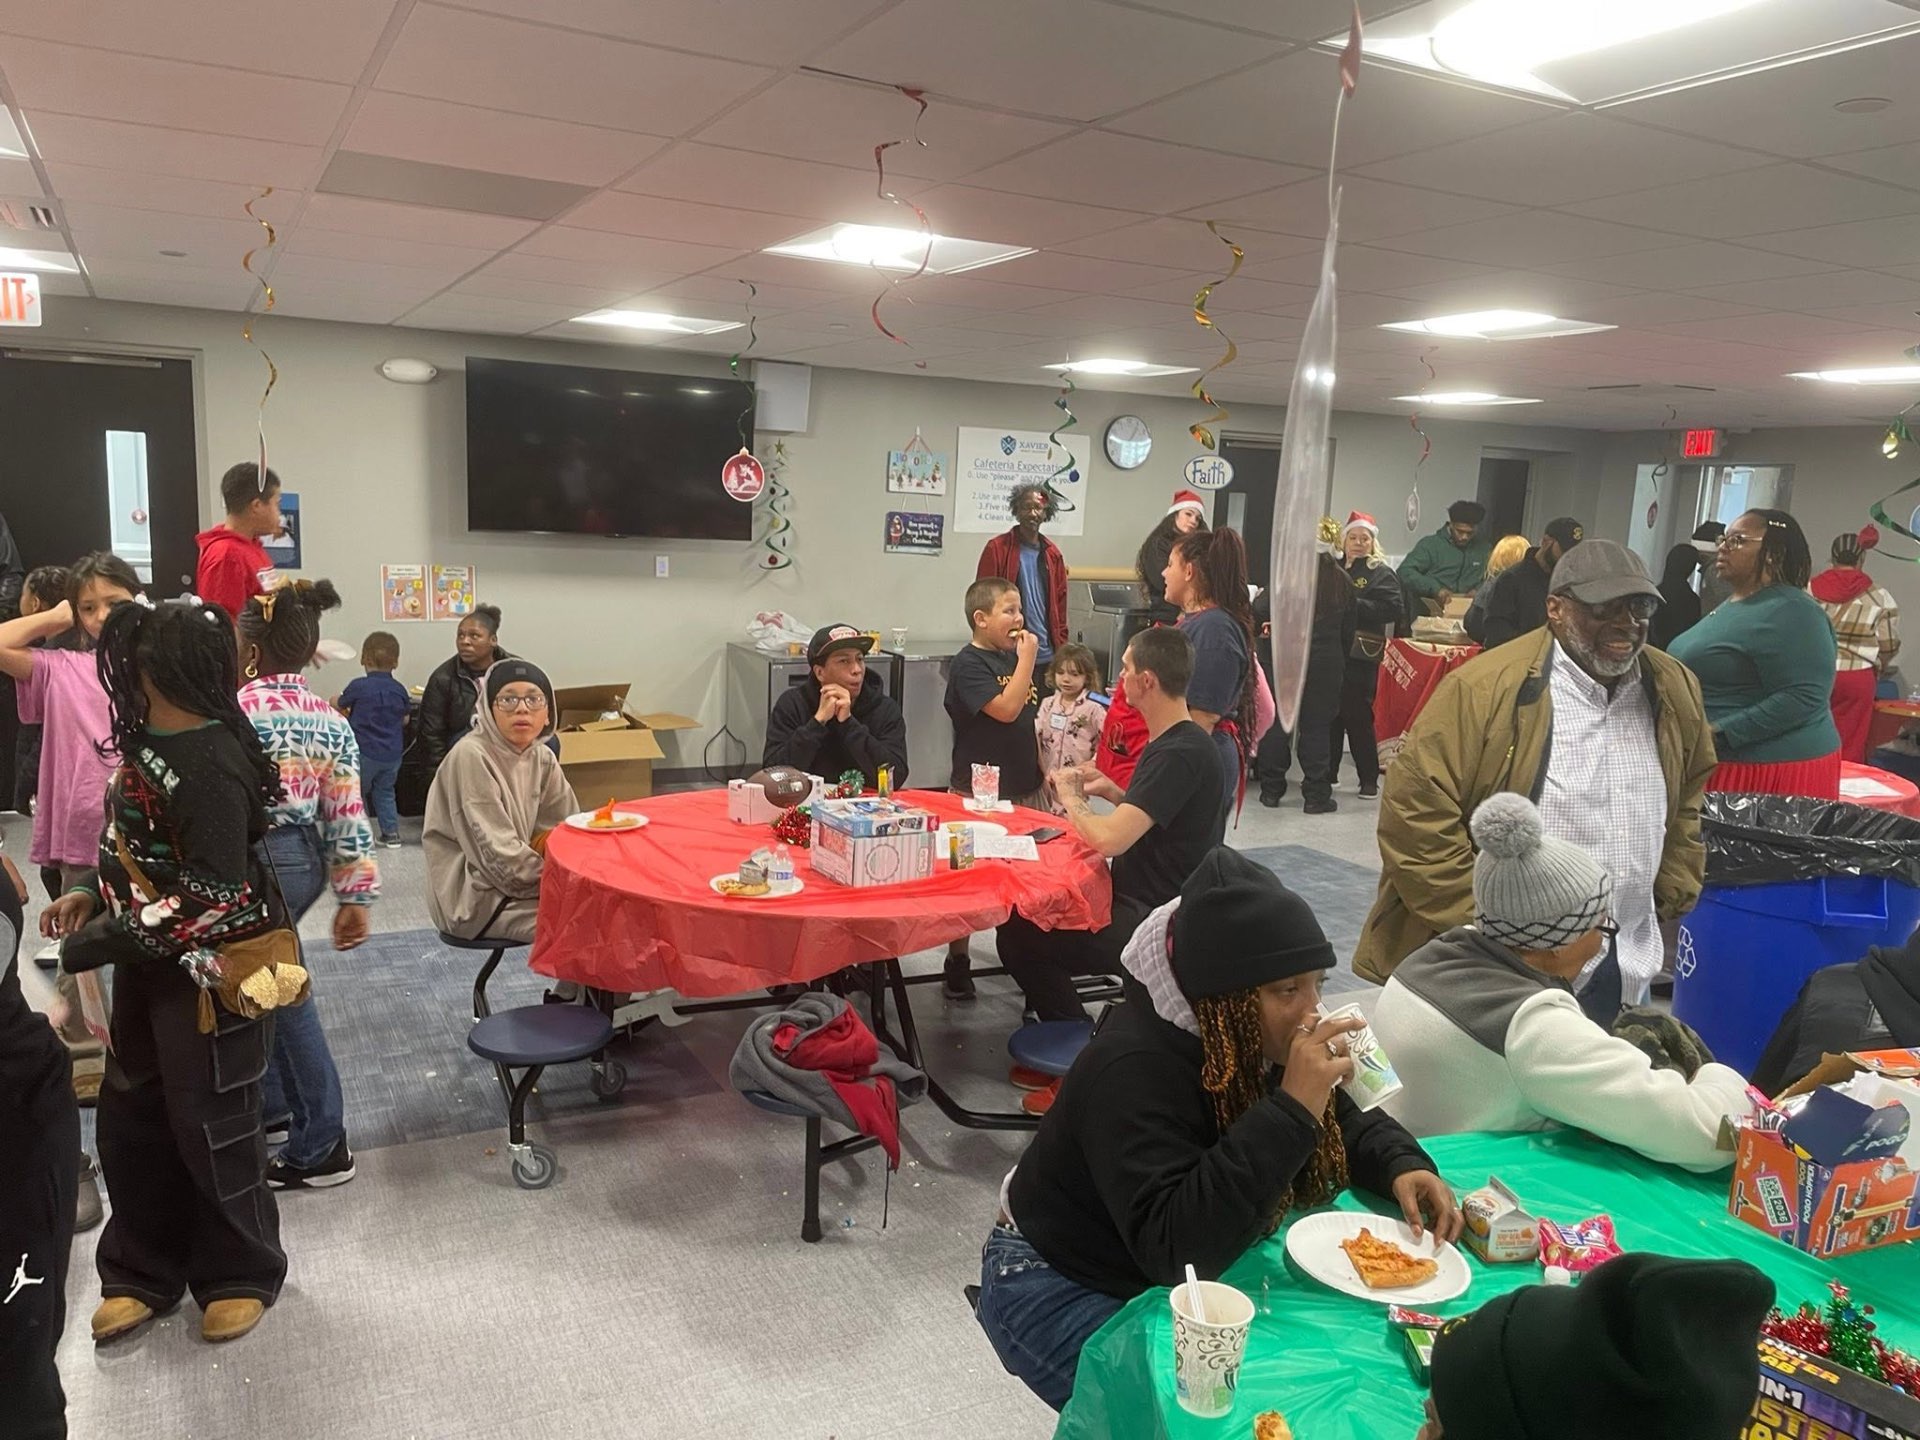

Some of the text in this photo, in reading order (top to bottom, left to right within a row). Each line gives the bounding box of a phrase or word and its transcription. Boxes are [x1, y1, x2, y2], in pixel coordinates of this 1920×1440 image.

[0, 277, 27, 321] IT
[1019, 442, 1049, 450] XAVIER
[1685, 430, 1715, 456] EXIT
[973, 458, 1069, 475] Cafeteria Expectatio
[1192, 459, 1225, 485] Faith
[997, 675, 1013, 686] SAT
[1864, 1133, 1908, 1151] POGO
[1803, 1164, 1815, 1225] POGO HOPPER
[1773, 1199, 1788, 1222] 2036
[1757, 1342, 1841, 1385] NSTER
[1758, 1354, 1797, 1375] AB
